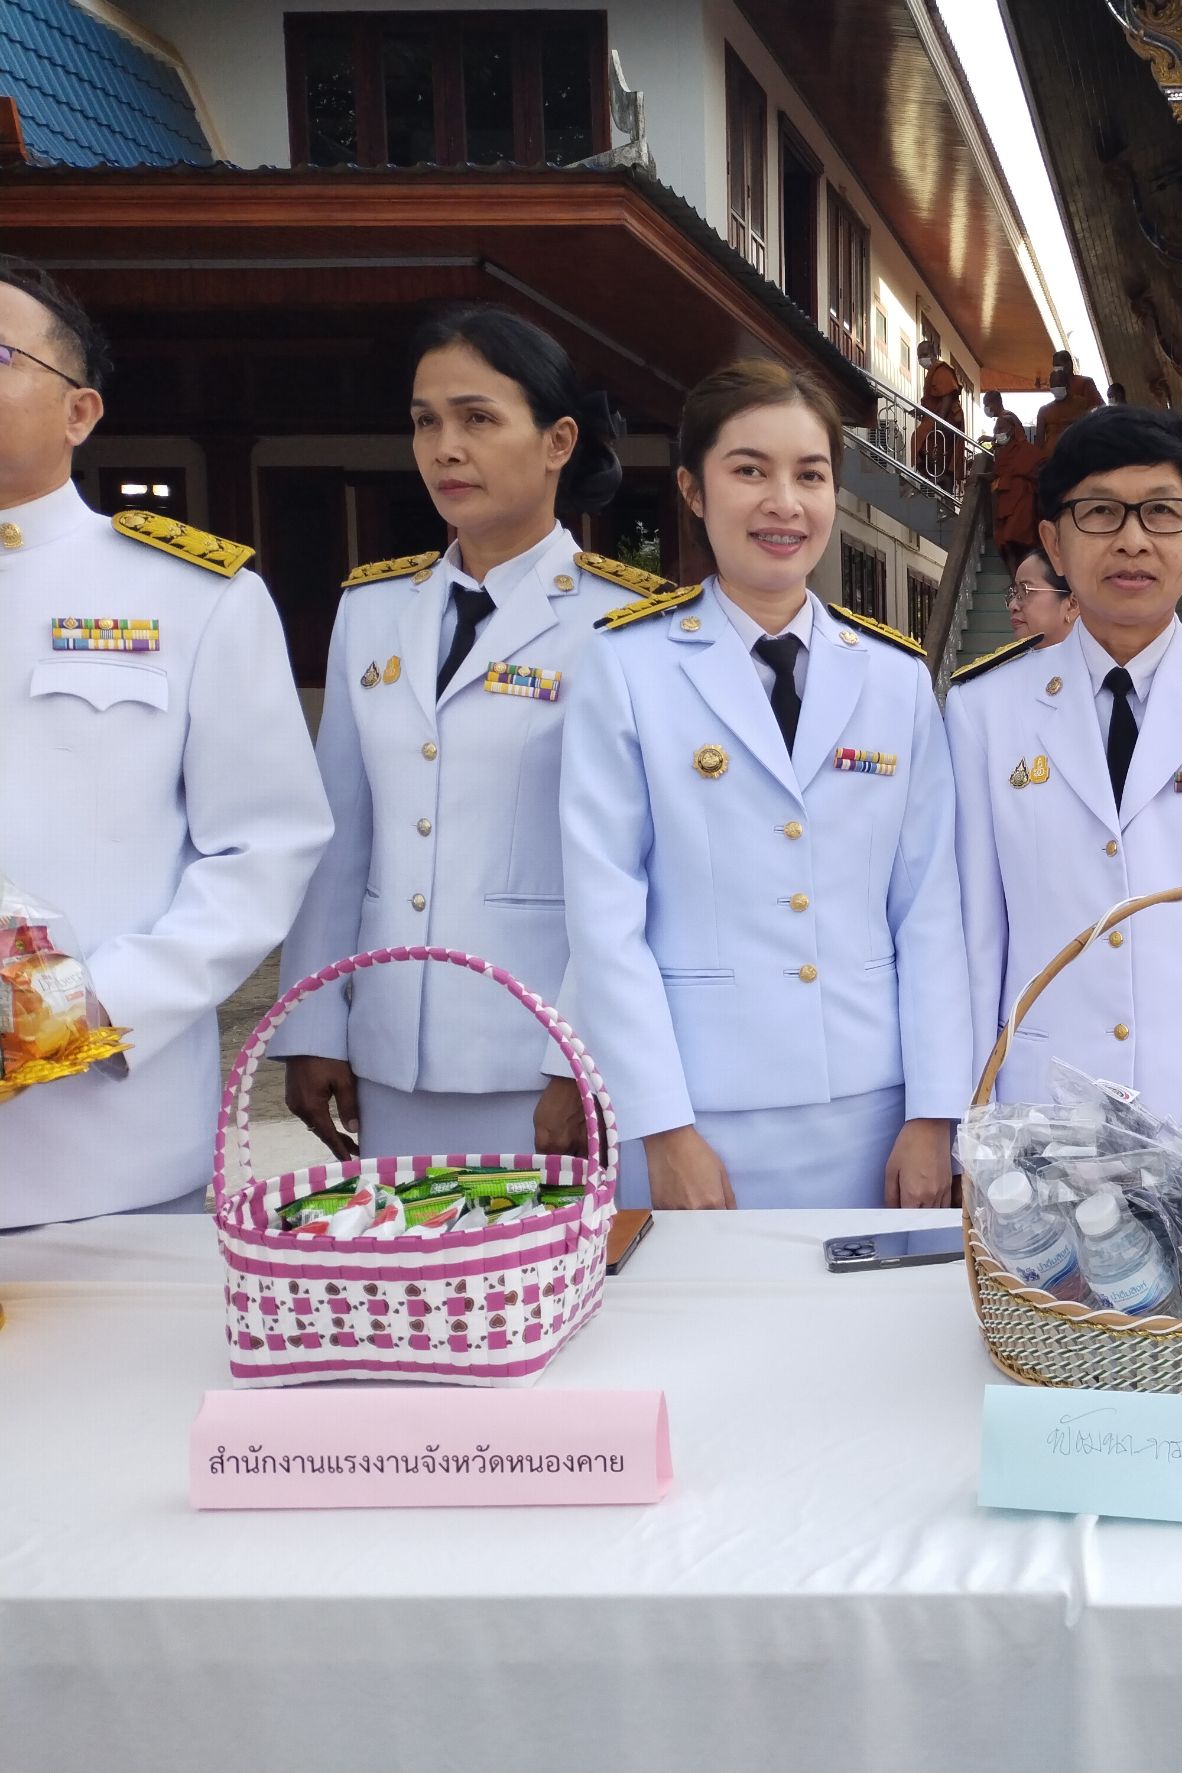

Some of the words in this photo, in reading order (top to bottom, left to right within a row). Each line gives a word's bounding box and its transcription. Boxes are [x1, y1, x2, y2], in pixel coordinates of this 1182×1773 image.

[208, 1443, 625, 1475] สำนักงานแรงงานจังหวัดหนองคาย
